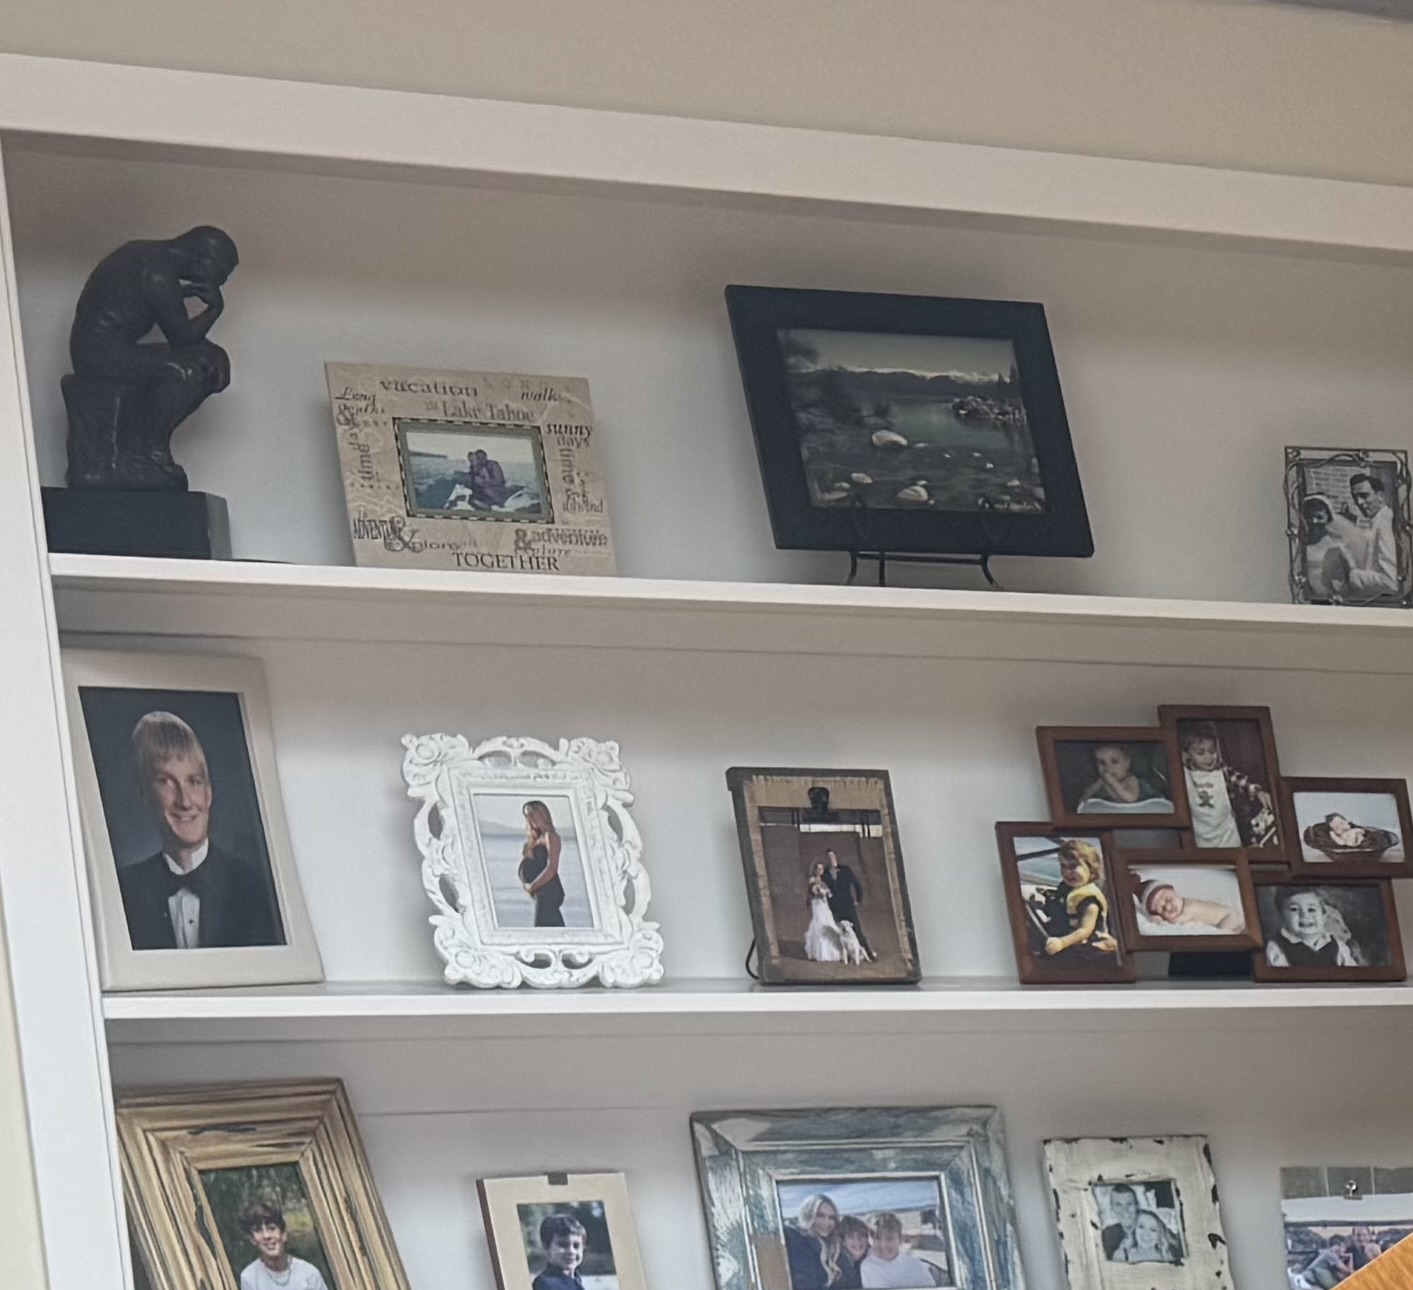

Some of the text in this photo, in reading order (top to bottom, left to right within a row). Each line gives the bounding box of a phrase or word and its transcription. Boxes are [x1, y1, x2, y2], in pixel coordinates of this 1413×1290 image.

[380, 380, 478, 397] vacation
[443, 400, 484, 419] Lake
[487, 403, 536, 424] Tahoe
[546, 423, 593, 442] sunny
[451, 551, 560, 571] TOGETHER
